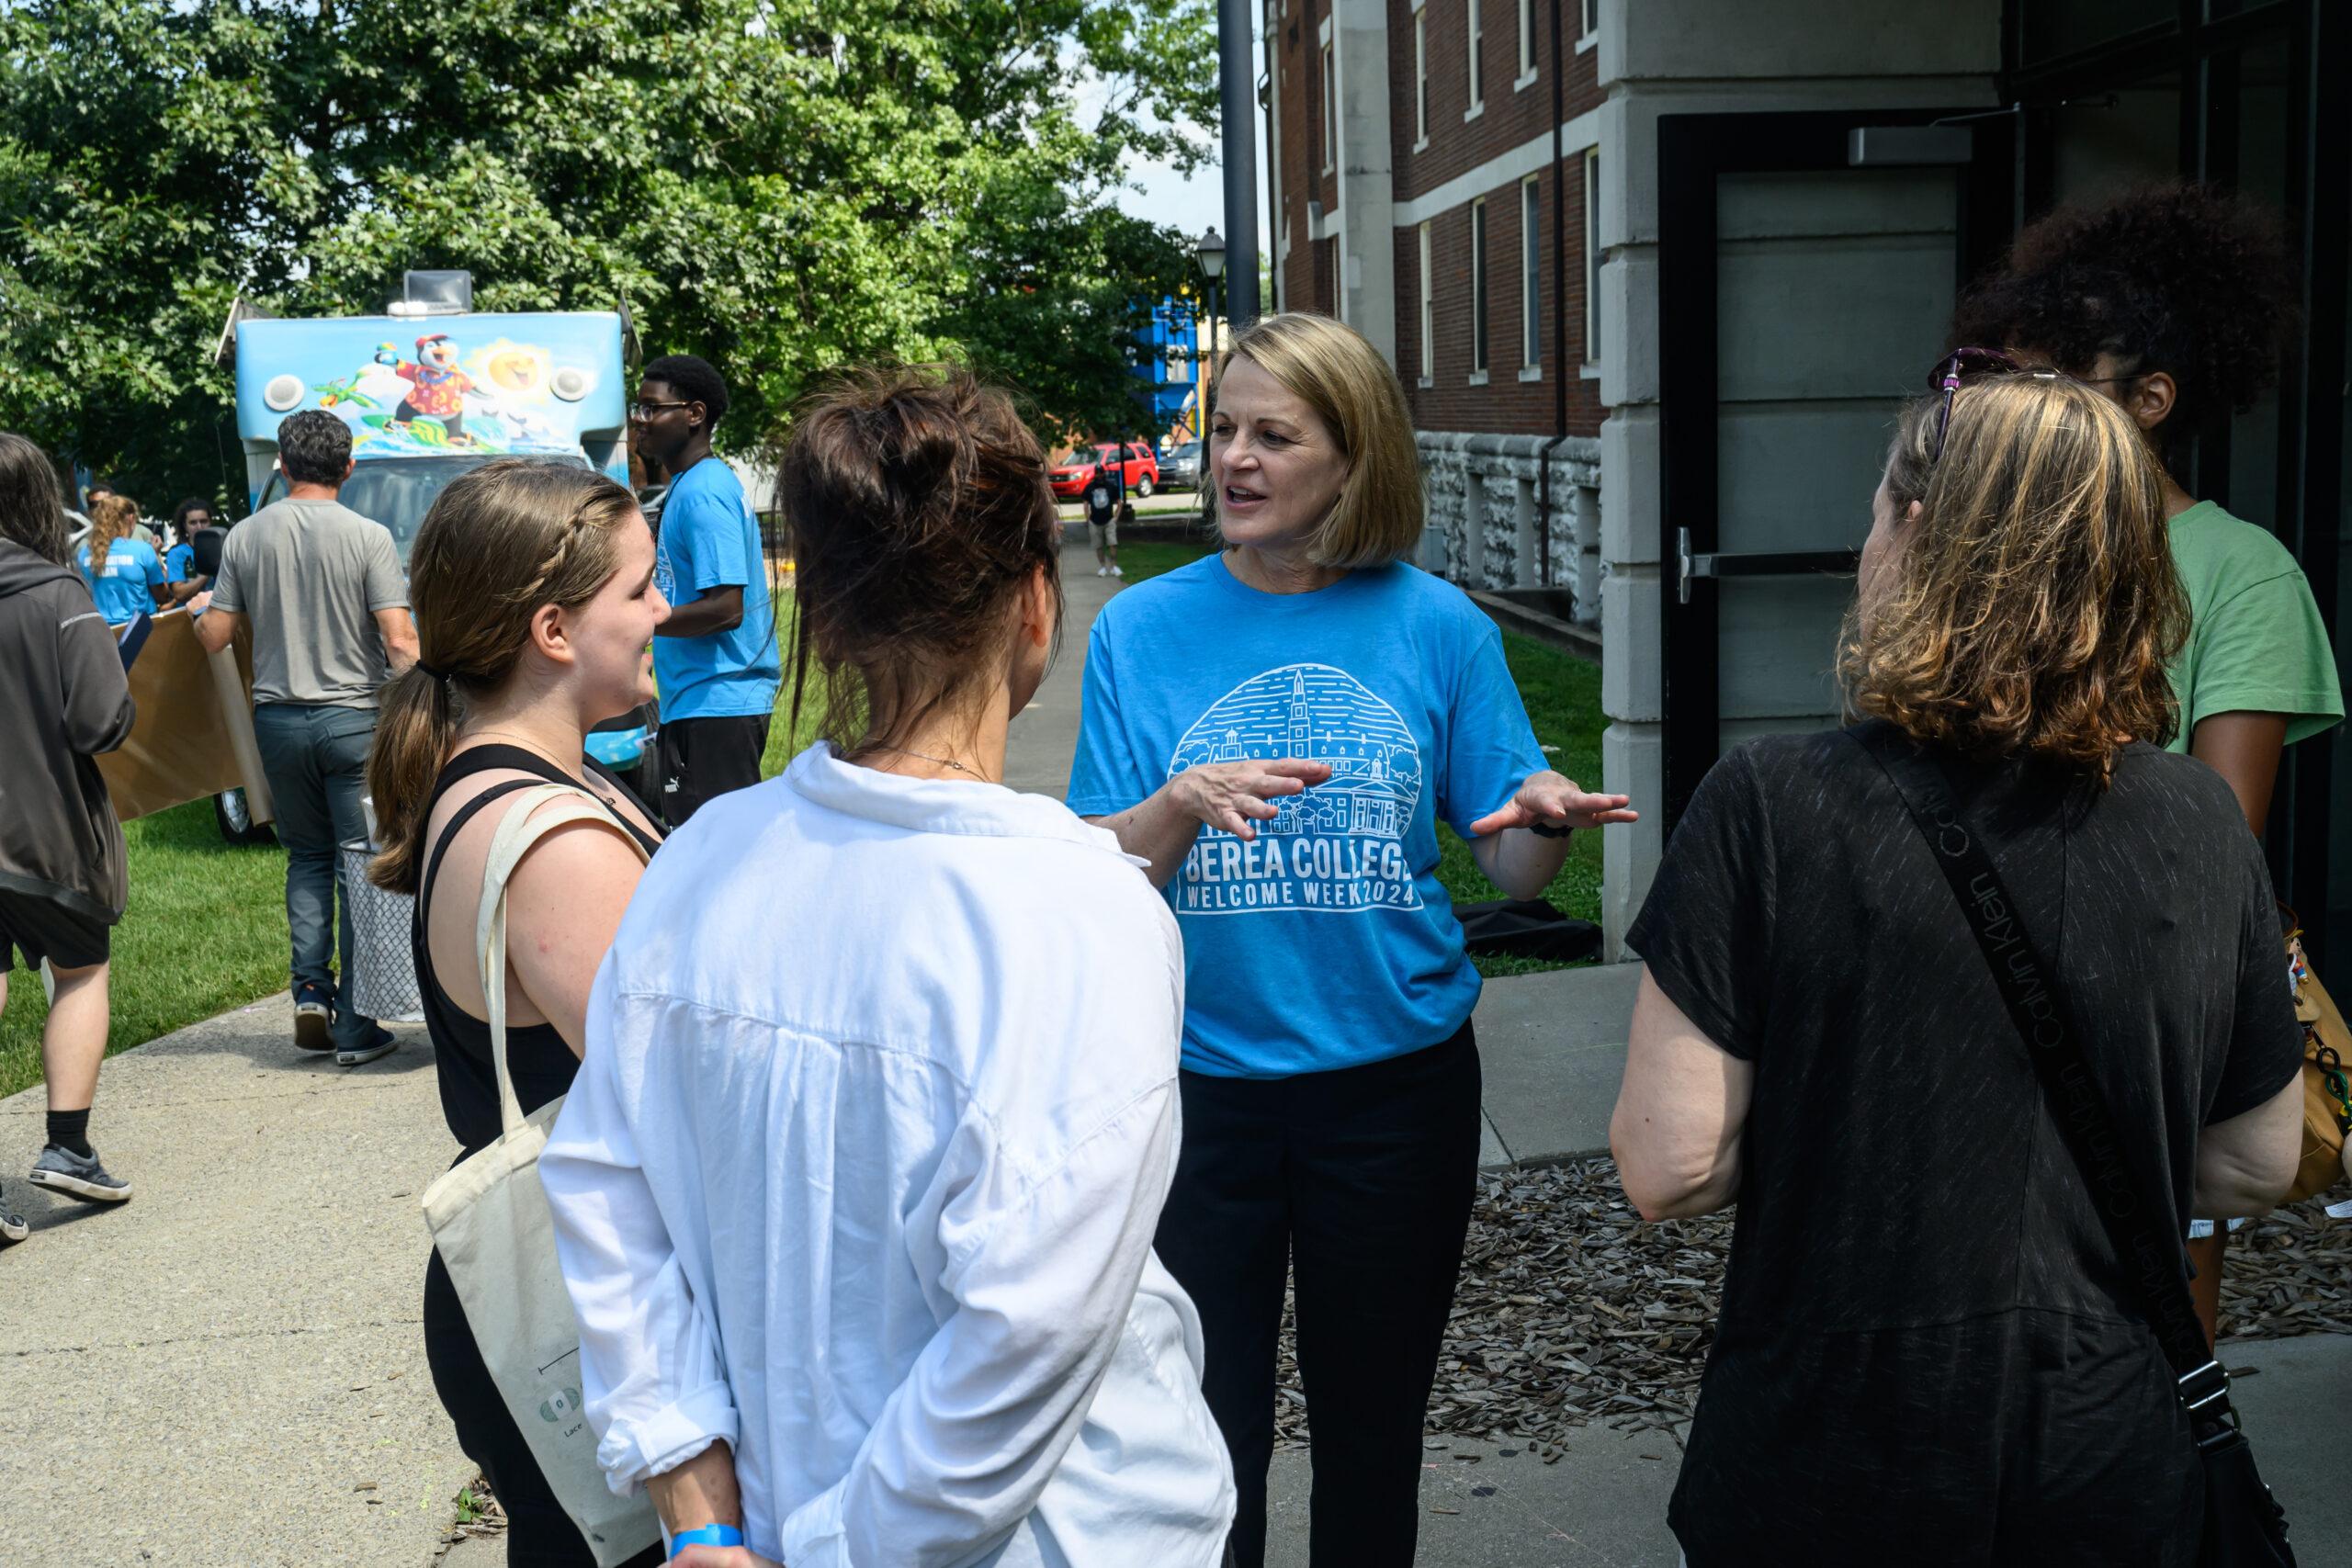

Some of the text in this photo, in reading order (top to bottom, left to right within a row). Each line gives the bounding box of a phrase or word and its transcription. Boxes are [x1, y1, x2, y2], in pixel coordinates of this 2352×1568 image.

[1186, 838, 1286, 883] BEREA
[1187, 880, 1414, 908] WELCOME WEEK 2024
[1970, 872, 2064, 1048] Calvin Klein
